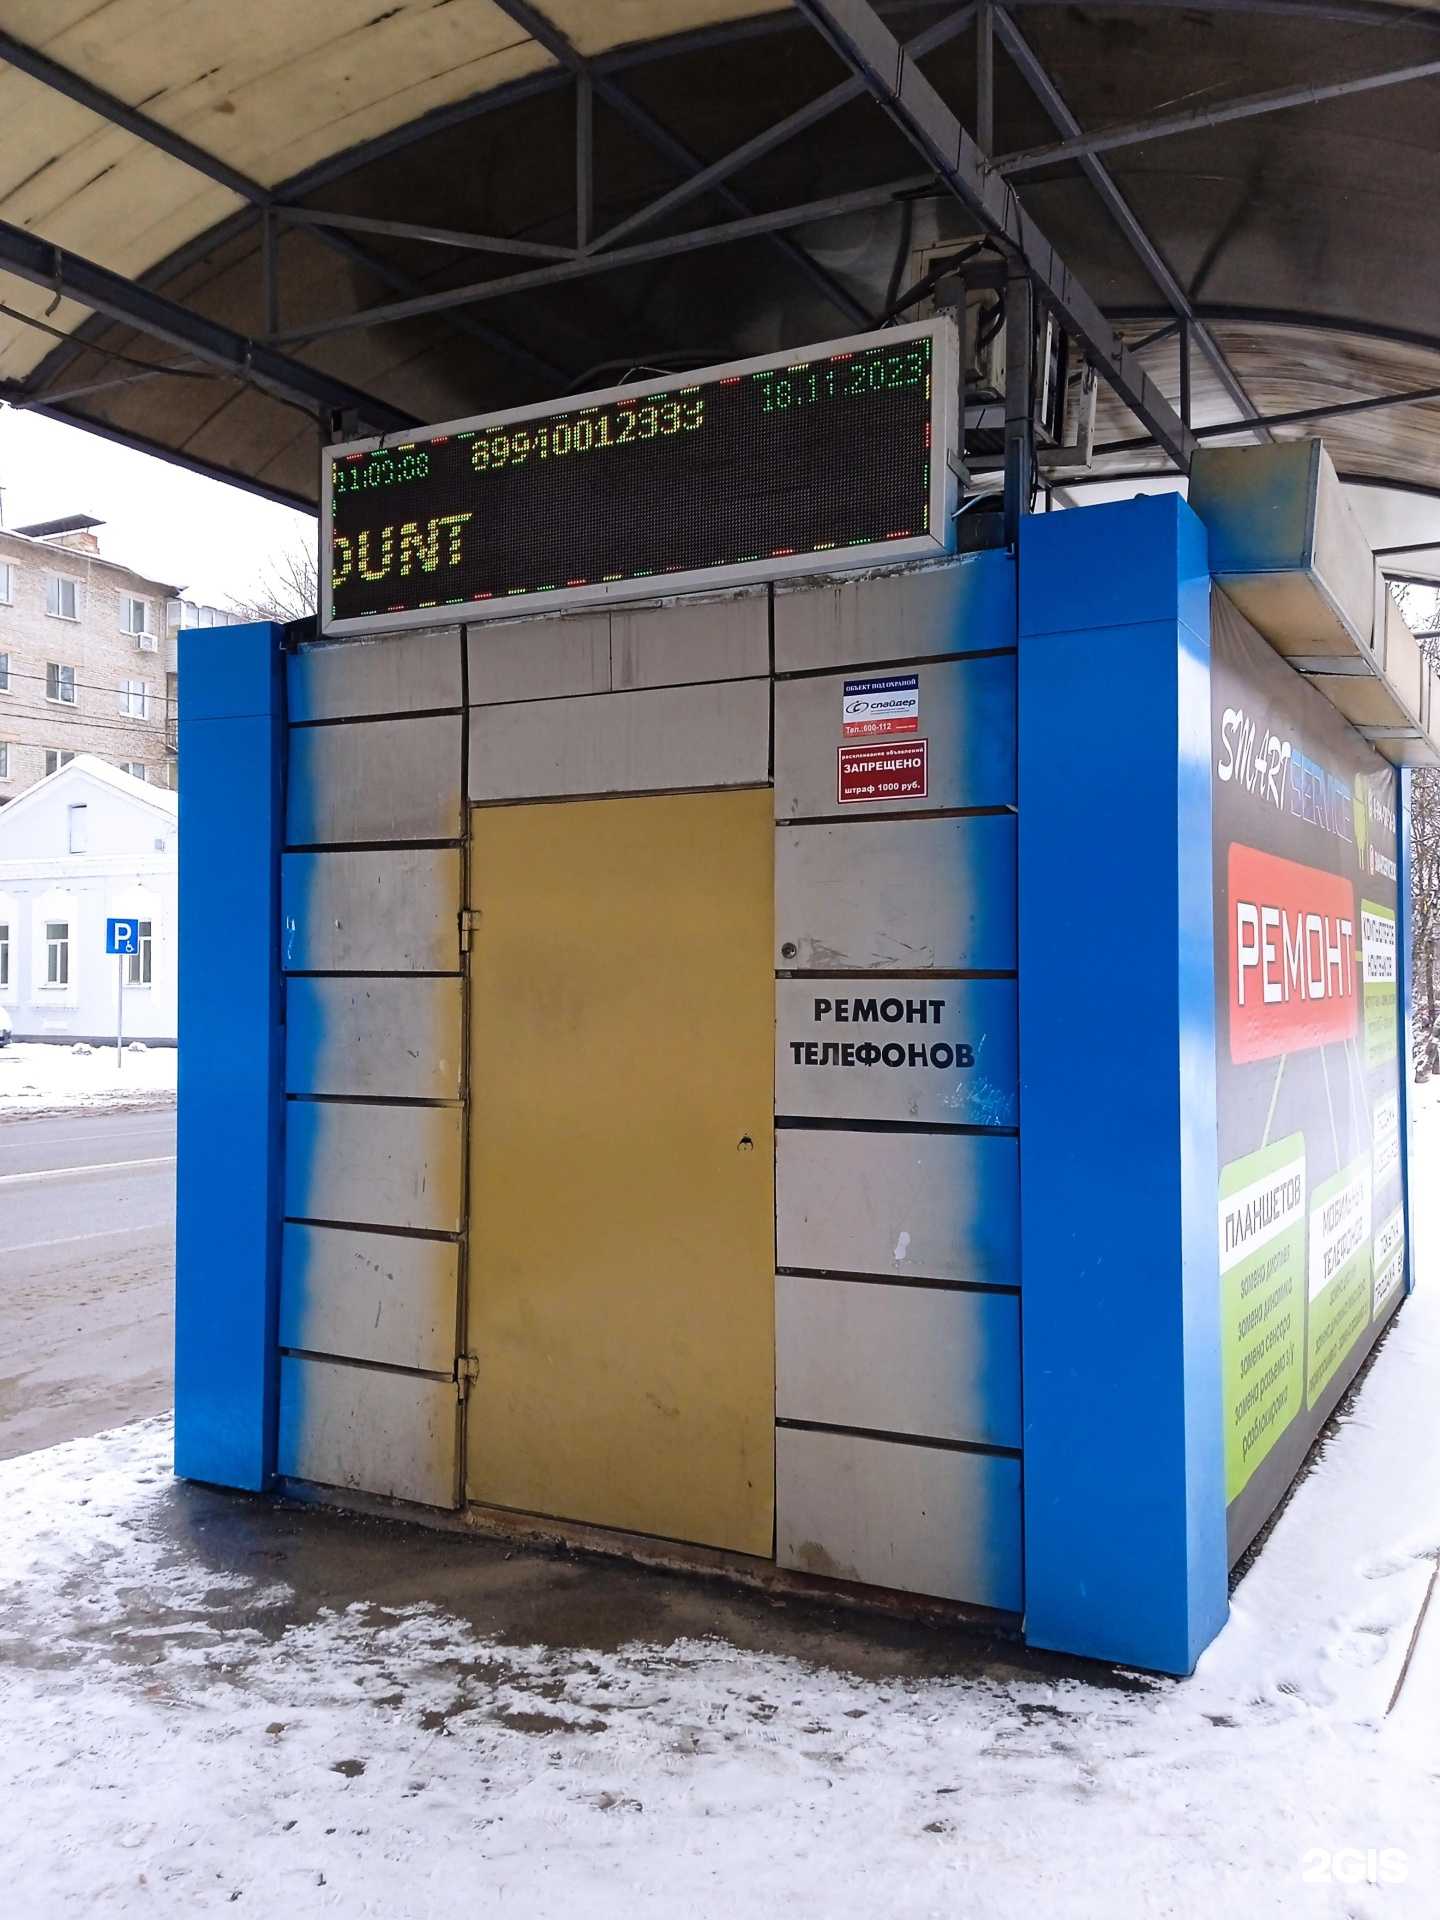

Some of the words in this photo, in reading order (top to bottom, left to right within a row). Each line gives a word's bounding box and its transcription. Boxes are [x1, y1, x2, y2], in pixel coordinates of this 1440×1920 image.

[846, 684, 871, 692] ОБЪЕКТ
[871, 682, 886, 690] ПОД
[886, 678, 916, 688] ОХРАНОЙ
[843, 758, 922, 774] ЗАПРЕЩЕНО
[1218, 708, 1292, 811] SMART
[844, 784, 875, 795] штраф
[877, 783, 899, 792] 1000
[901, 780, 920, 791] руб.
[114, 922, 132, 950] P
[1237, 902, 1353, 1005] РЕМОНТ
[814, 998, 946, 1024] РЕМОНТ
[790, 1042, 976, 1069] ТЕЛЕФОНОВ
[1225, 1174, 1301, 1252] ПЛАНШЕТОВ
